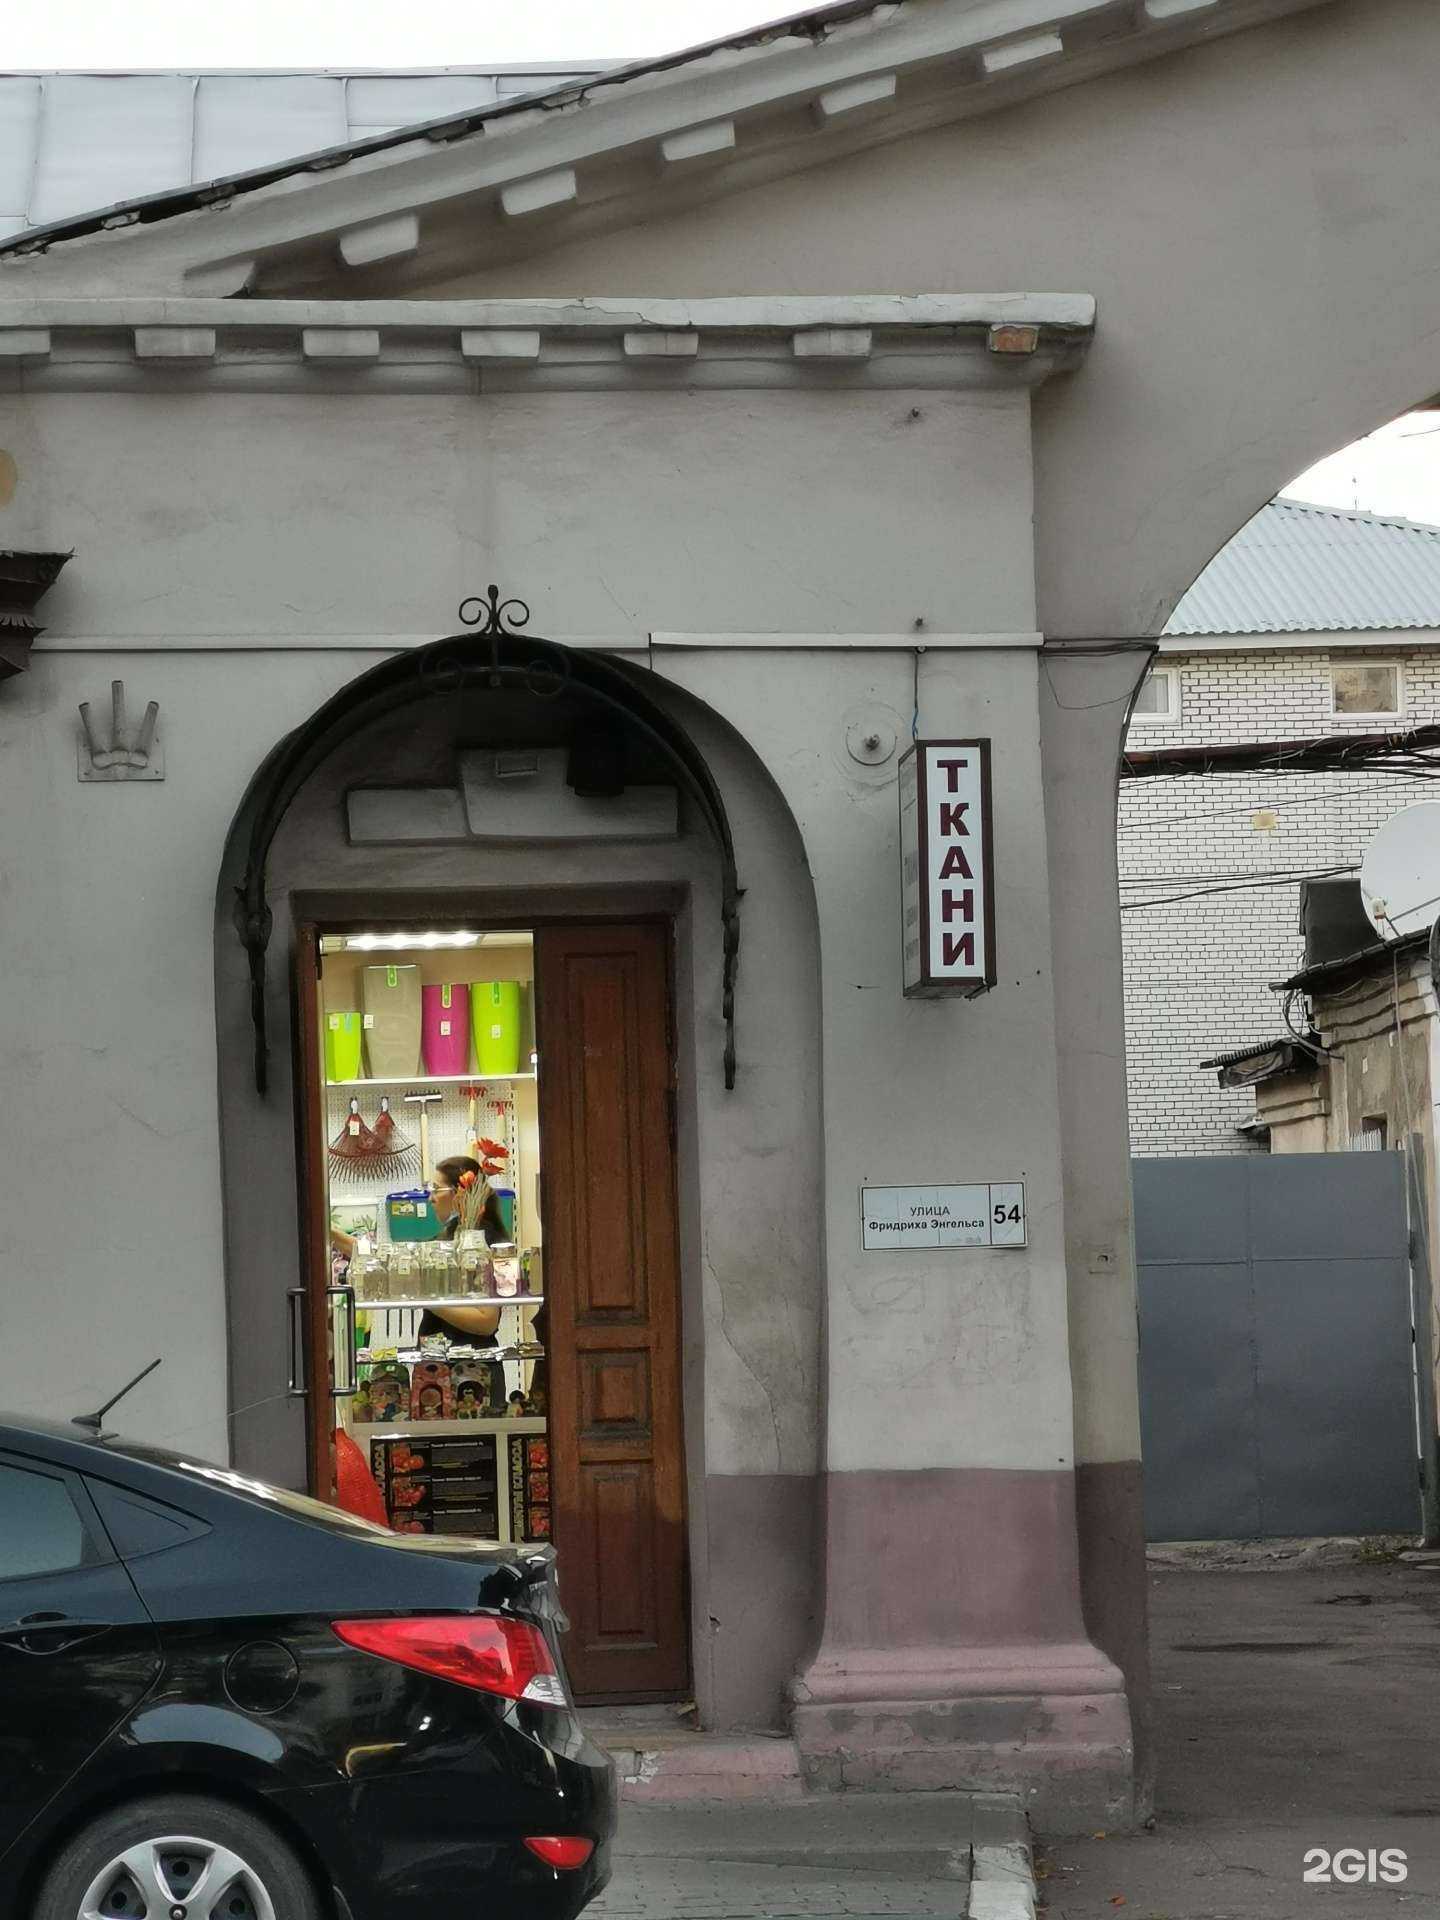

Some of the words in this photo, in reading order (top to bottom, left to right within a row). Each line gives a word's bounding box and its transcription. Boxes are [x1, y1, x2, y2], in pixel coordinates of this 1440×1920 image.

[937, 760, 974, 965] ТКАНИ
[911, 1206, 950, 1216] УЛИЦА
[993, 1204, 1021, 1224] 54
[869, 1219, 928, 1232] Фридриха
[931, 1219, 985, 1230] Энгельса
